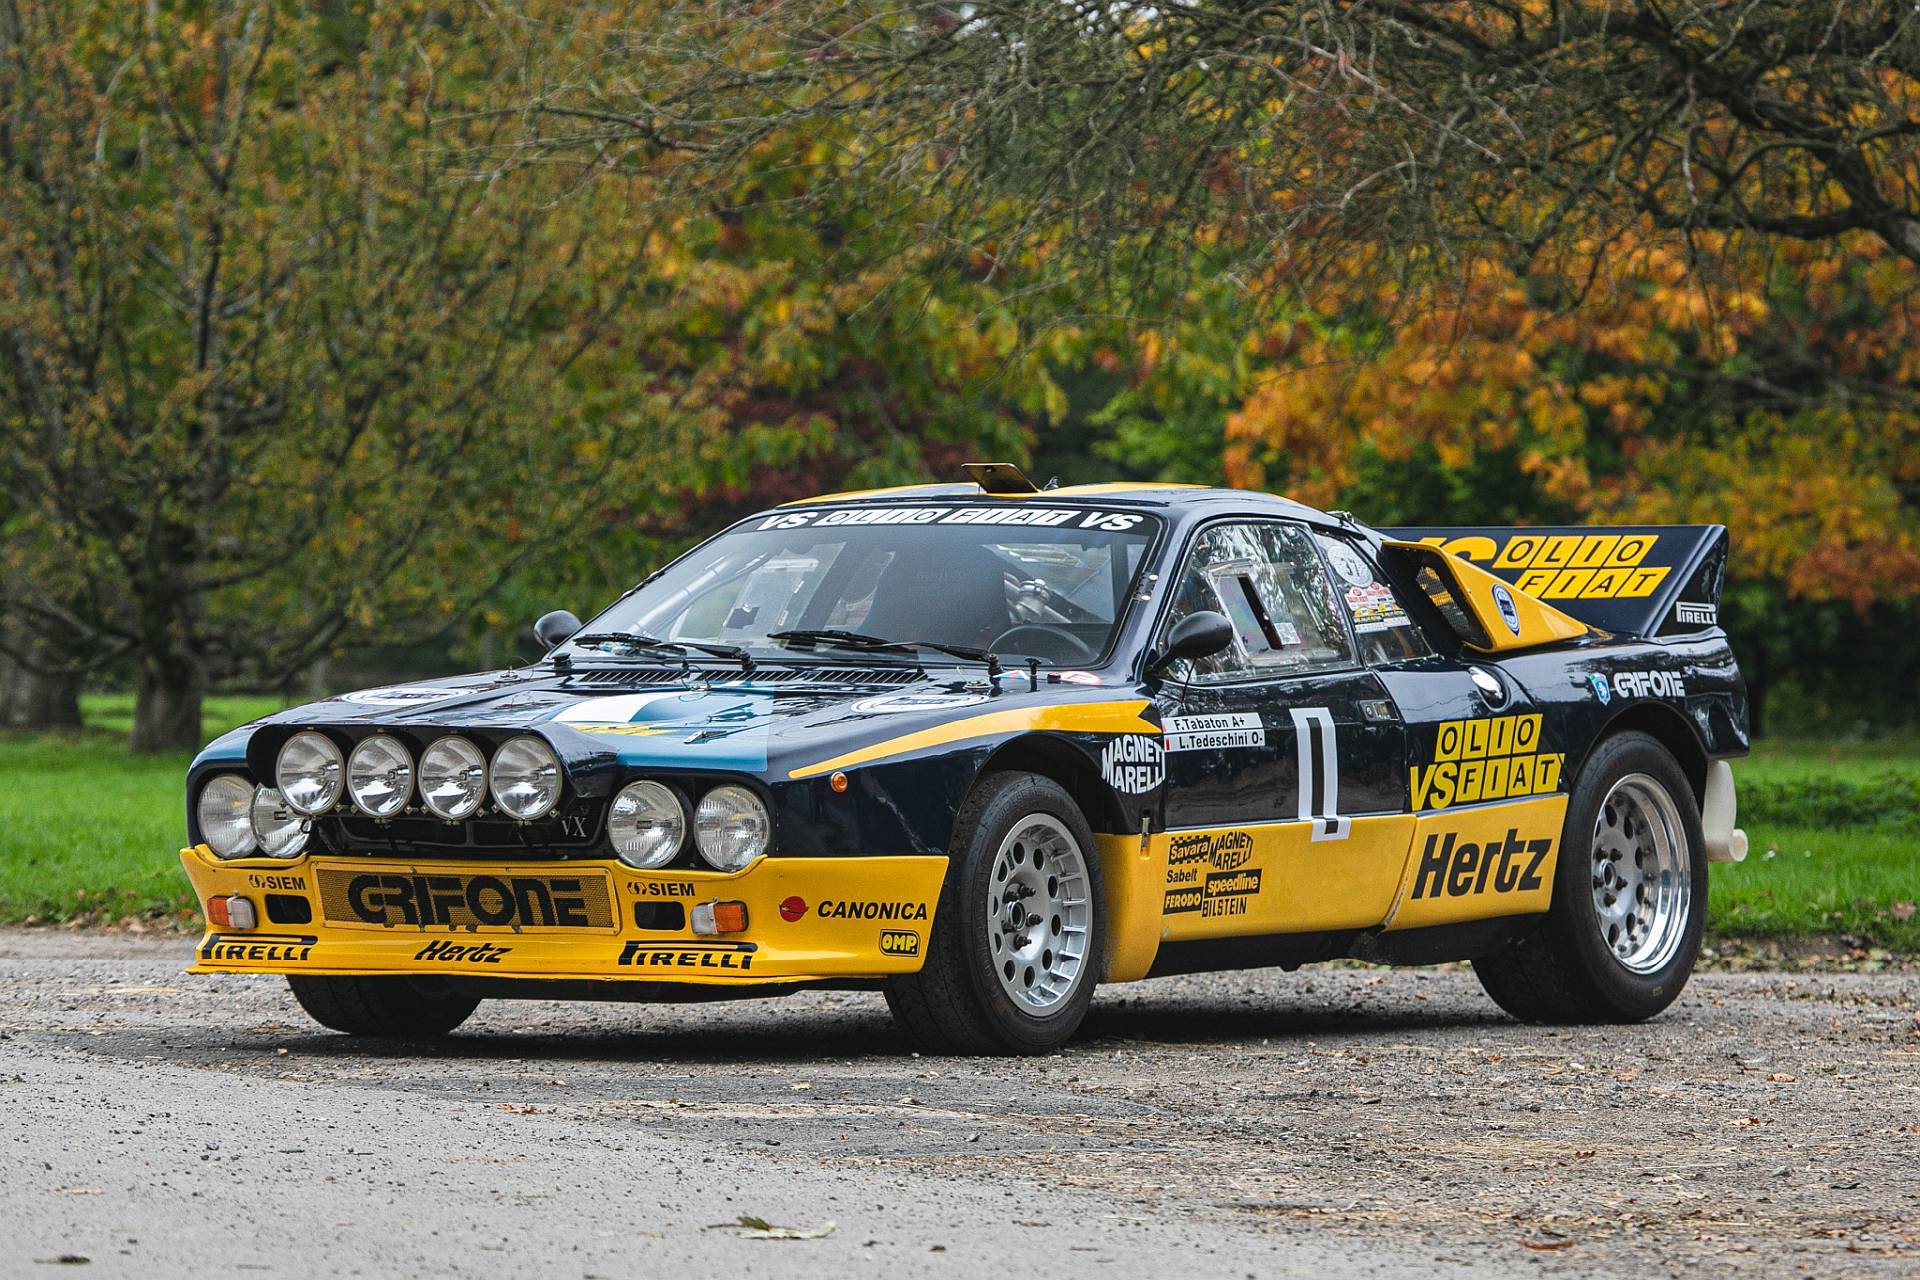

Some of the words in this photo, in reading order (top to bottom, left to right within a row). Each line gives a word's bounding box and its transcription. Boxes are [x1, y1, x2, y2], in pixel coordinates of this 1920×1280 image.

[757, 511, 819, 531] VS
[817, 509, 947, 525] OLIO
[943, 509, 1076, 525] FIAT
[1078, 511, 1144, 531] VS
[1499, 537, 1651, 566] OLIO
[1516, 570, 1665, 595] FIAT
[1676, 601, 1717, 625] PIRELLI
[1613, 670, 1686, 698] GRIFONE
[1174, 717, 1229, 731] F.Tabaton
[1232, 716, 1245, 727] A+
[1102, 734, 1166, 764] MAGNETI
[1179, 731, 1248, 749] L.Tedeschini
[1438, 715, 1540, 759] OLIO
[1101, 765, 1166, 794] MARELLI
[1410, 762, 1460, 811] VS
[1459, 755, 1561, 797] FIAT
[1170, 842, 1208, 860] Savara
[1167, 868, 1197, 884] Sabelt
[1411, 828, 1552, 900] Hertz
[266, 875, 306, 890] SIEM
[648, 882, 695, 897] SIEM
[1207, 872, 1258, 896] speedline
[348, 876, 588, 927] GRIFONE
[817, 900, 928, 920] CANONICA
[1165, 892, 1201, 909] FERODO
[1202, 897, 1247, 917] BILSTEIN
[201, 933, 318, 961] PIRELLI
[413, 940, 513, 963] Hertz
[618, 940, 758, 970] PIRELLI
